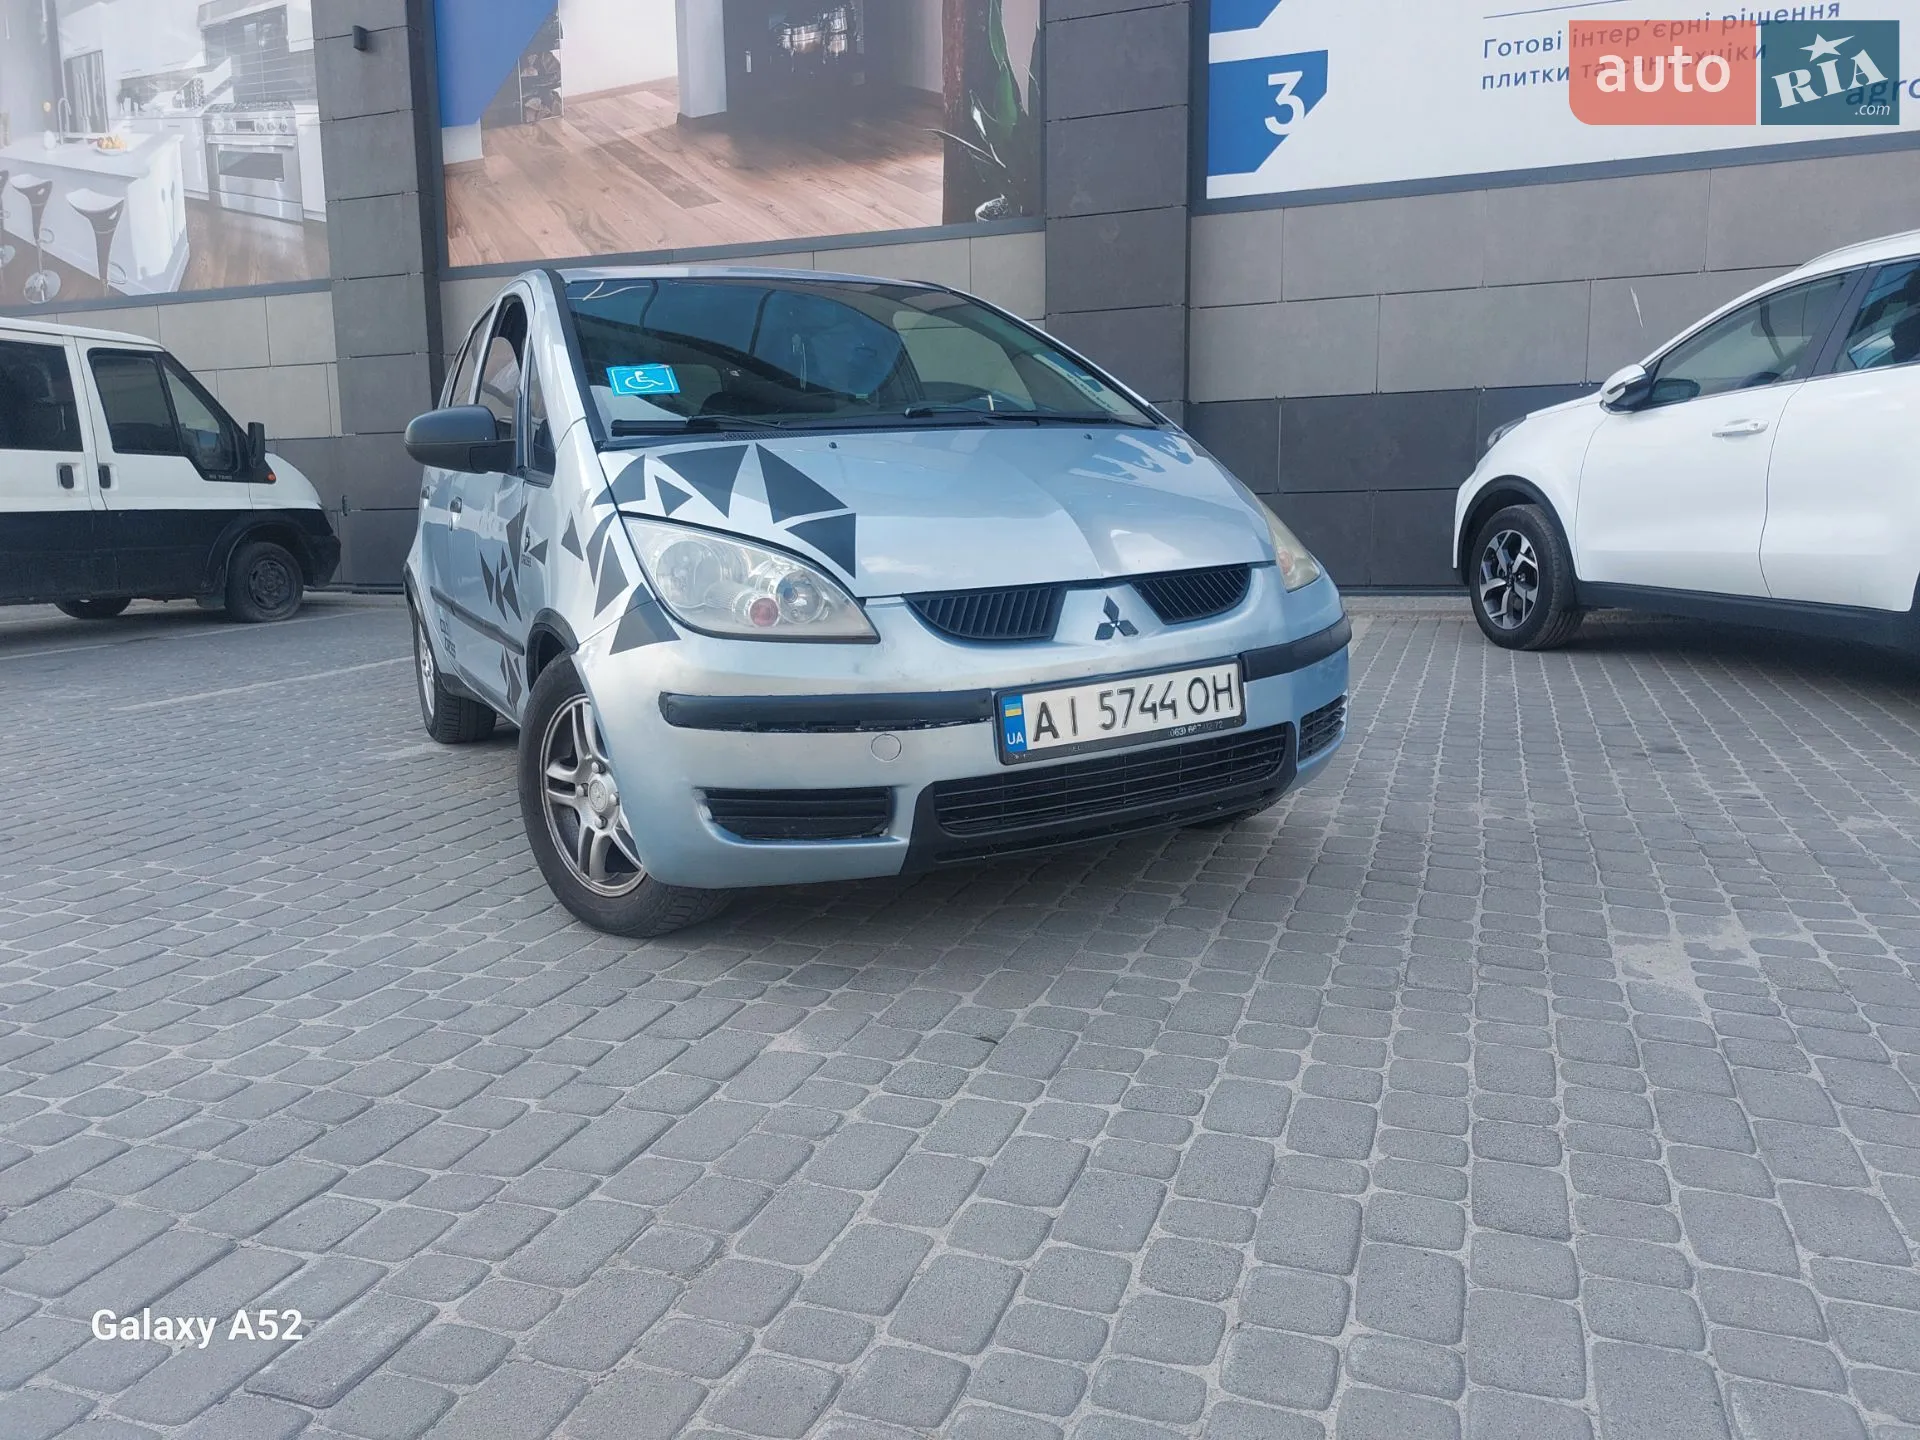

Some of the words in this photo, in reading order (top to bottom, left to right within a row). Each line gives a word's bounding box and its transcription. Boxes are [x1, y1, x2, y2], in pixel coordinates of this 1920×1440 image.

[1483, 29, 1562, 59] Готові
[1721, 2, 1841, 36] рішення
[1264, 70, 1306, 136] 3
[1482, 65, 1570, 90] плитки
[1032, 695, 1079, 742] AI
[1099, 680, 1179, 732] 5744
[1186, 672, 1236, 716] OH
[1006, 732, 1025, 746] UA
